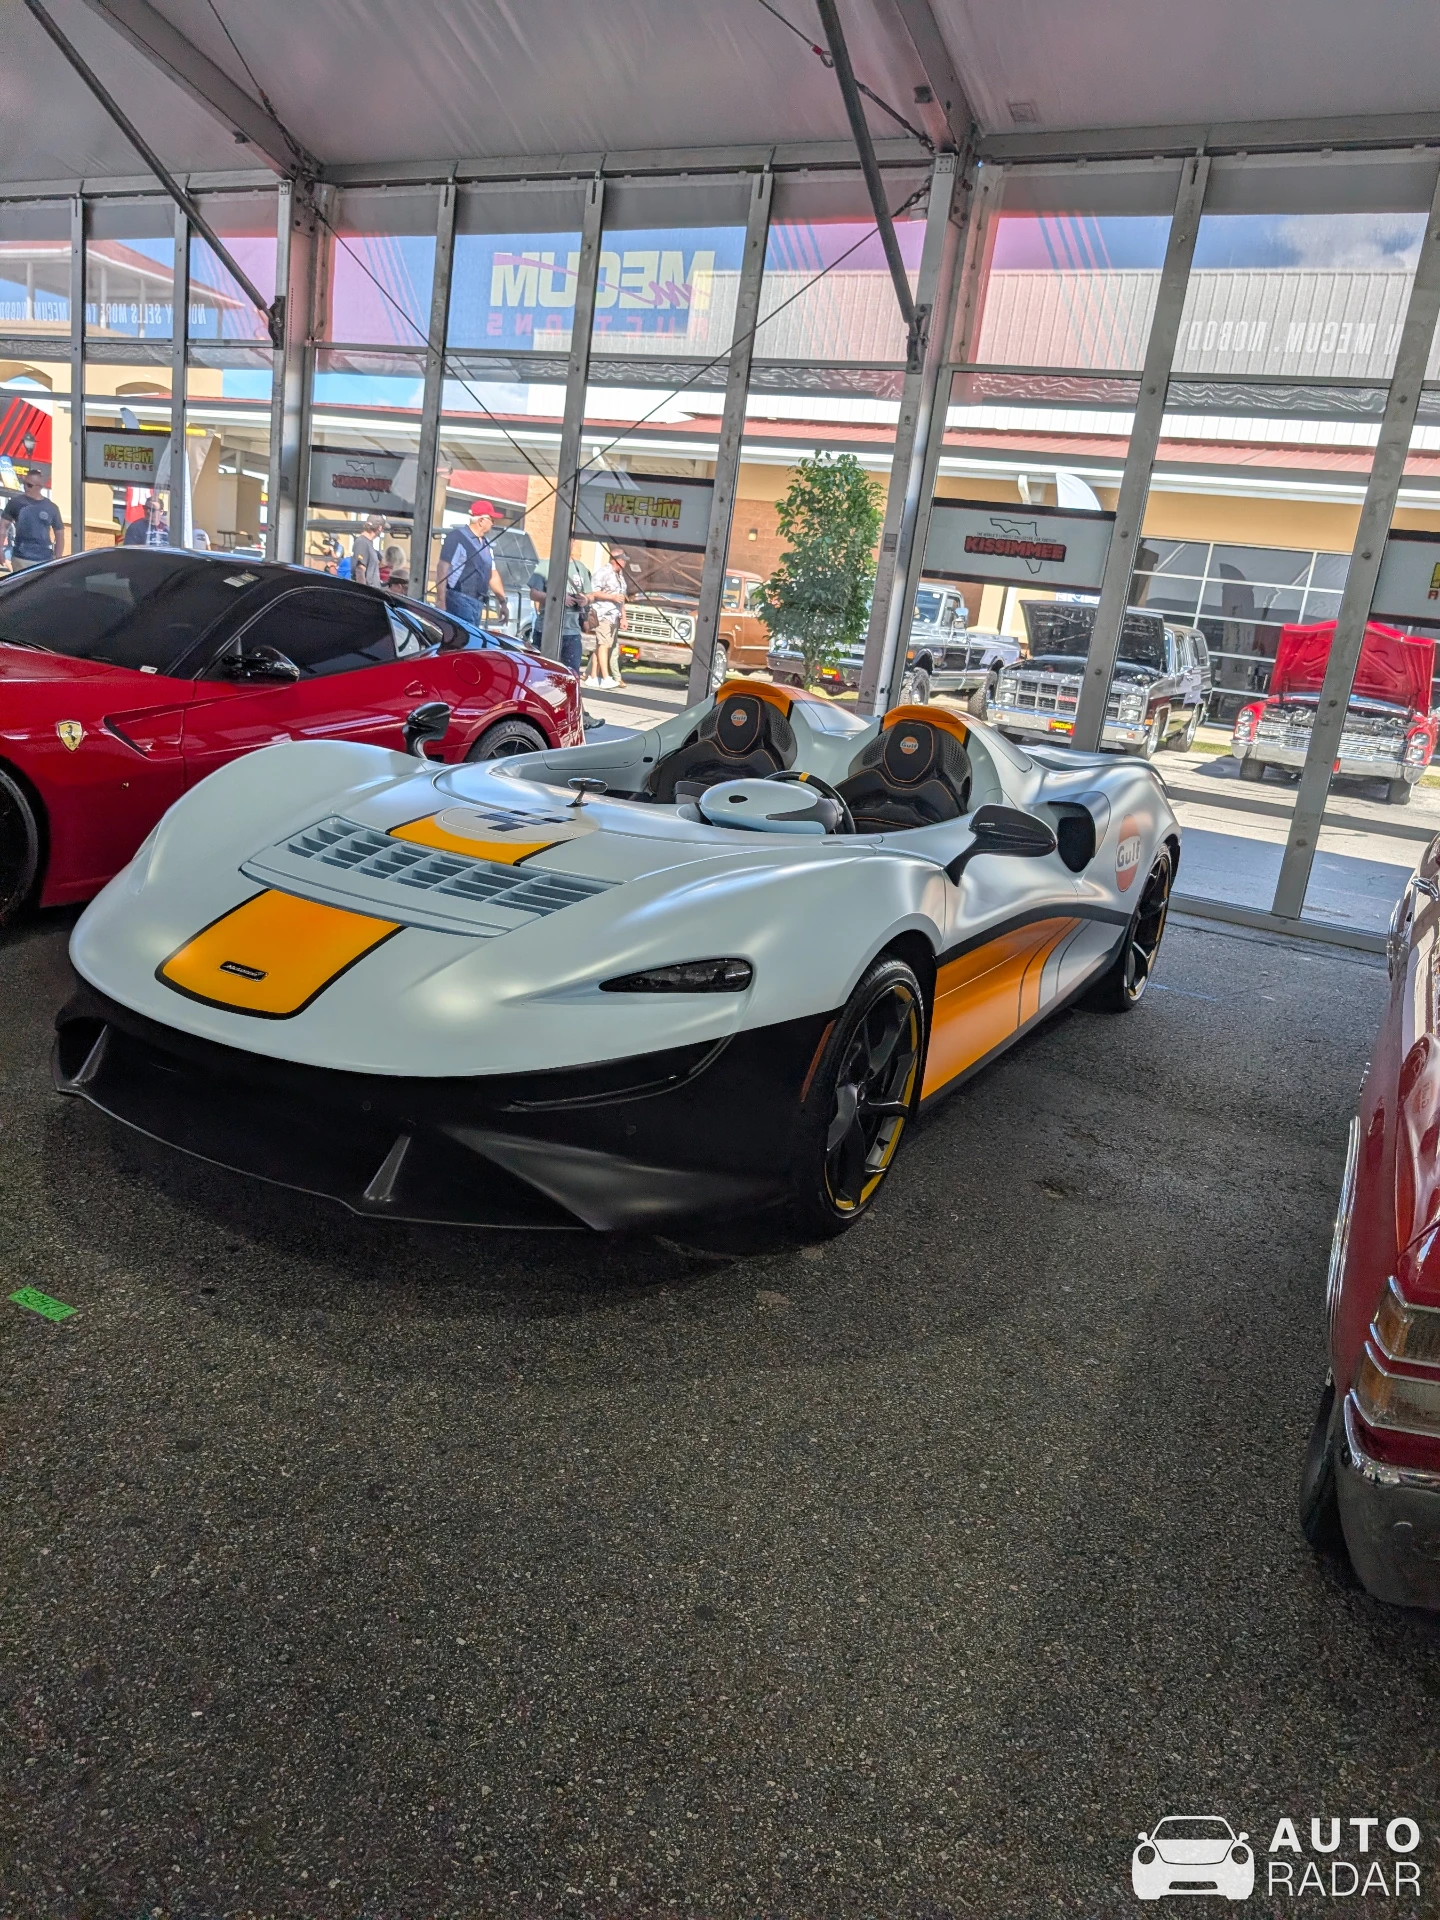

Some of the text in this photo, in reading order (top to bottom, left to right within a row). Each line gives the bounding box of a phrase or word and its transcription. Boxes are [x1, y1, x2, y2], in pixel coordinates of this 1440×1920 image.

[103, 444, 155, 464] MECUM
[103, 461, 154, 472] AUCTIONS
[604, 493, 682, 520] MECUM
[603, 513, 679, 529] AUCTIONS
[964, 536, 1067, 562] KISSIMMEE
[1116, 840, 1140, 868] Gulf
